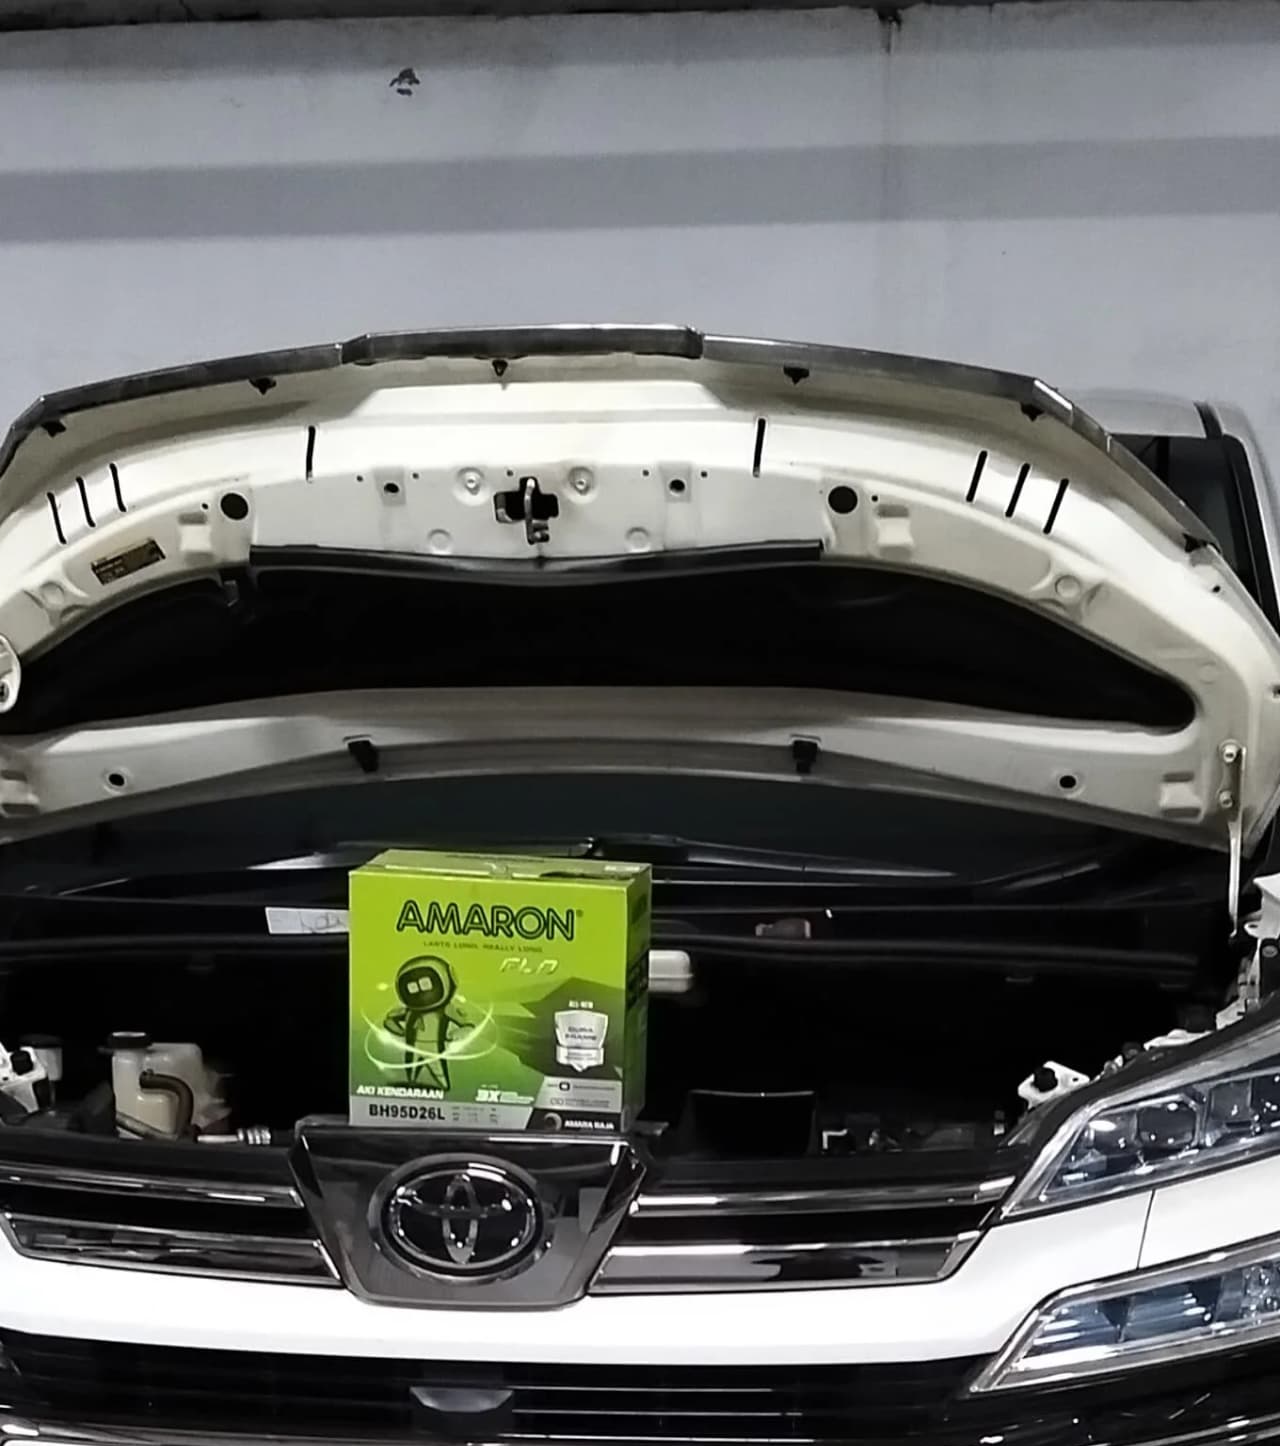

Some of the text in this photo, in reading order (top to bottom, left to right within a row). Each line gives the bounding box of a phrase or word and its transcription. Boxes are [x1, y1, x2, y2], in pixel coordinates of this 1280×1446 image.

[396, 899, 575, 941] AMARON
[377, 1086, 444, 1100] KENDARAAN
[369, 1104, 445, 1121] BH95D26L
